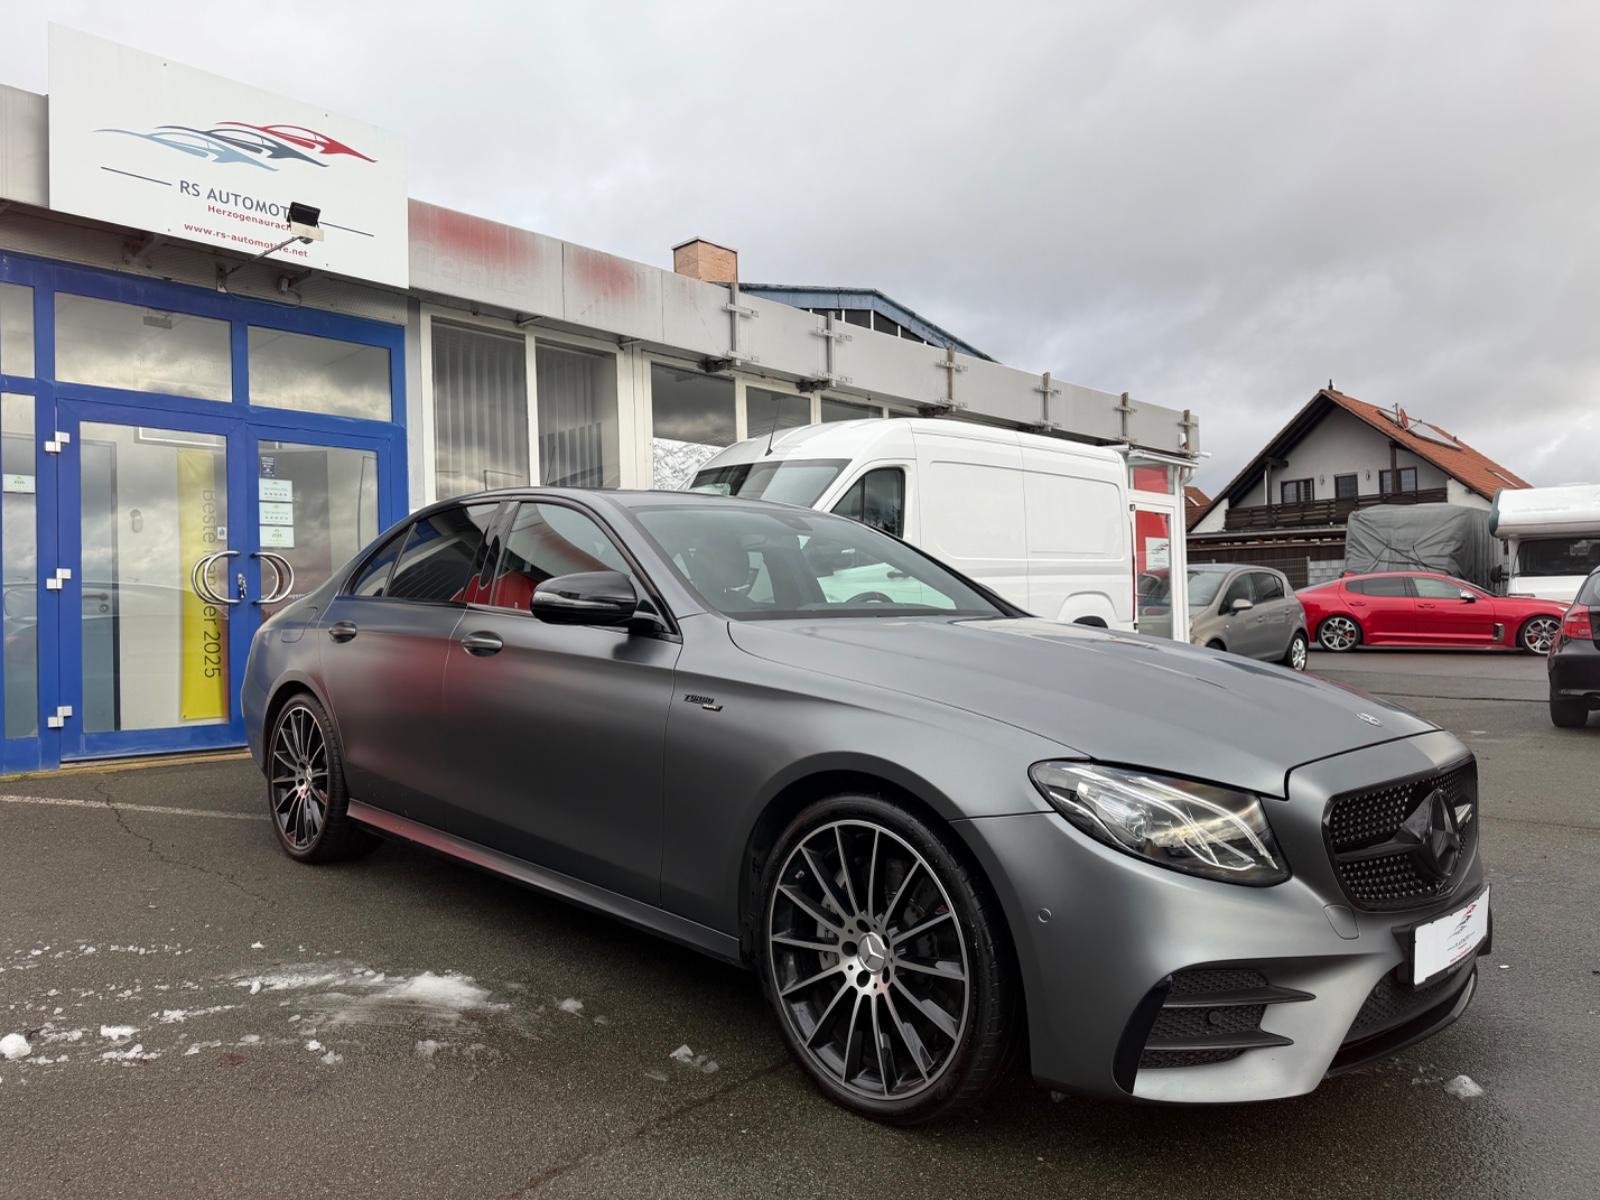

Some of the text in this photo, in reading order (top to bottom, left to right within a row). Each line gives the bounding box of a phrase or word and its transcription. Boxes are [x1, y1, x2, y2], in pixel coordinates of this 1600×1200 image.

[179, 181, 290, 220] RS AUTOMOT
[207, 204, 292, 232] Herzogenaurach
[202, 489, 217, 544] Beste
[203, 633, 221, 681] 2025
